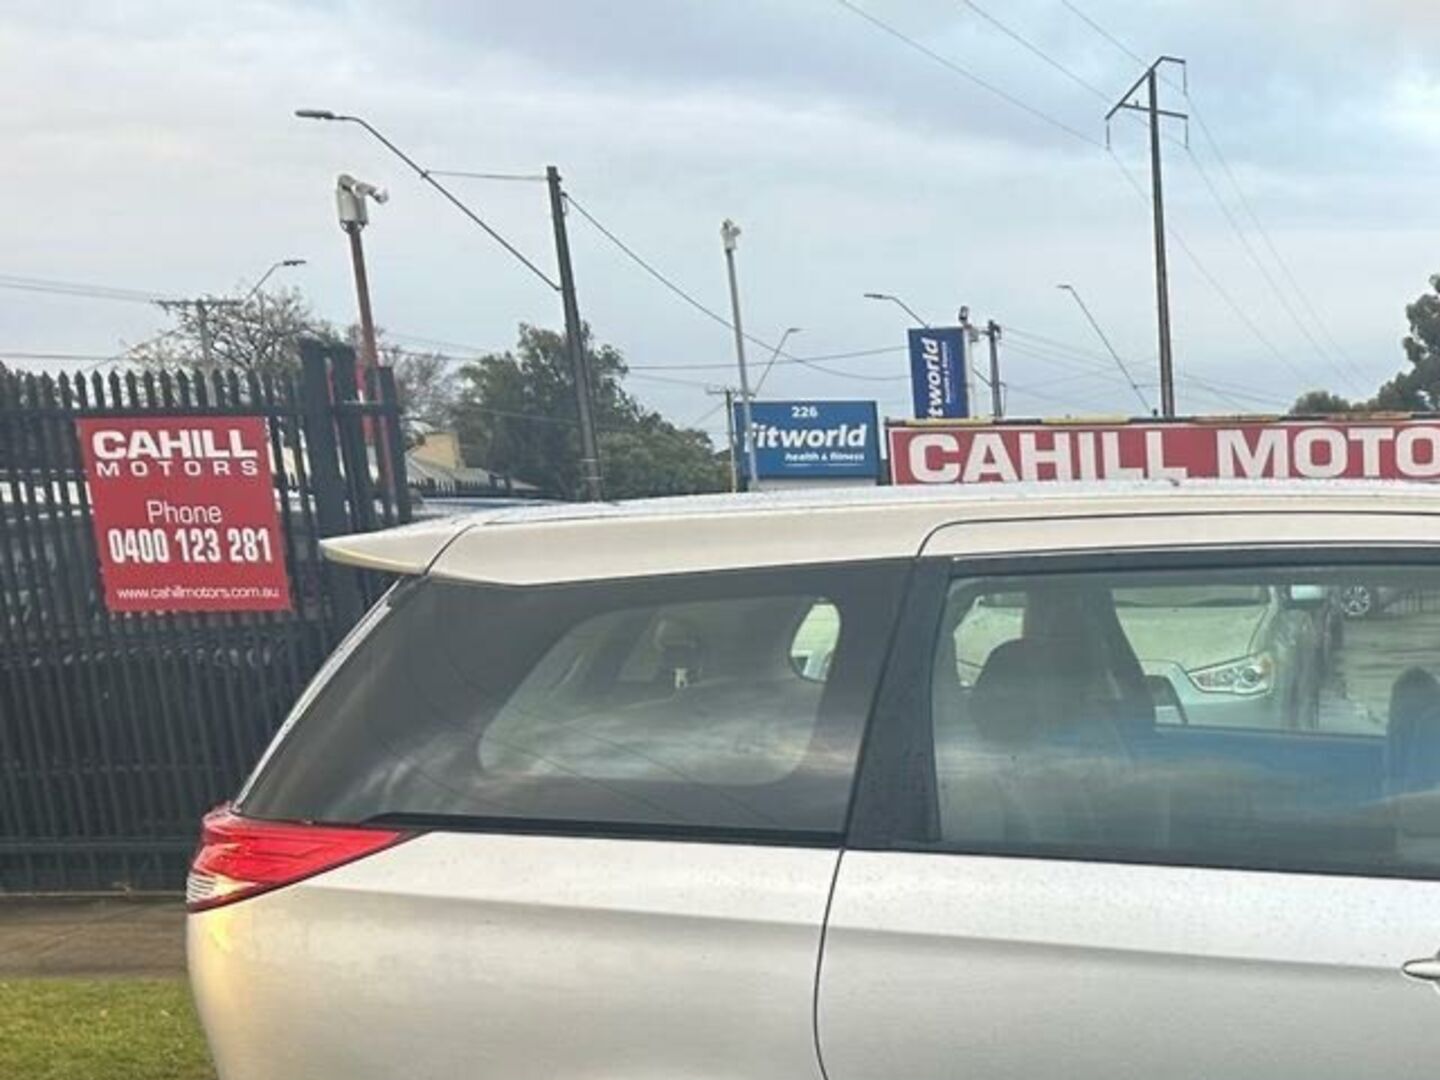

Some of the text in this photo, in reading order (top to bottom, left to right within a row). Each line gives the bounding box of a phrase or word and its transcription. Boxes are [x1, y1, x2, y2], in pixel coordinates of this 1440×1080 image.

[791, 406, 818, 418] 226
[92, 429, 258, 460] CAHILL
[96, 461, 258, 477] MOTORS
[908, 431, 1189, 483] CAHILL
[146, 500, 222, 524] Phone
[108, 528, 273, 564] 0400 123 281
[116, 584, 280, 600] www.cahillmotors.com.au
